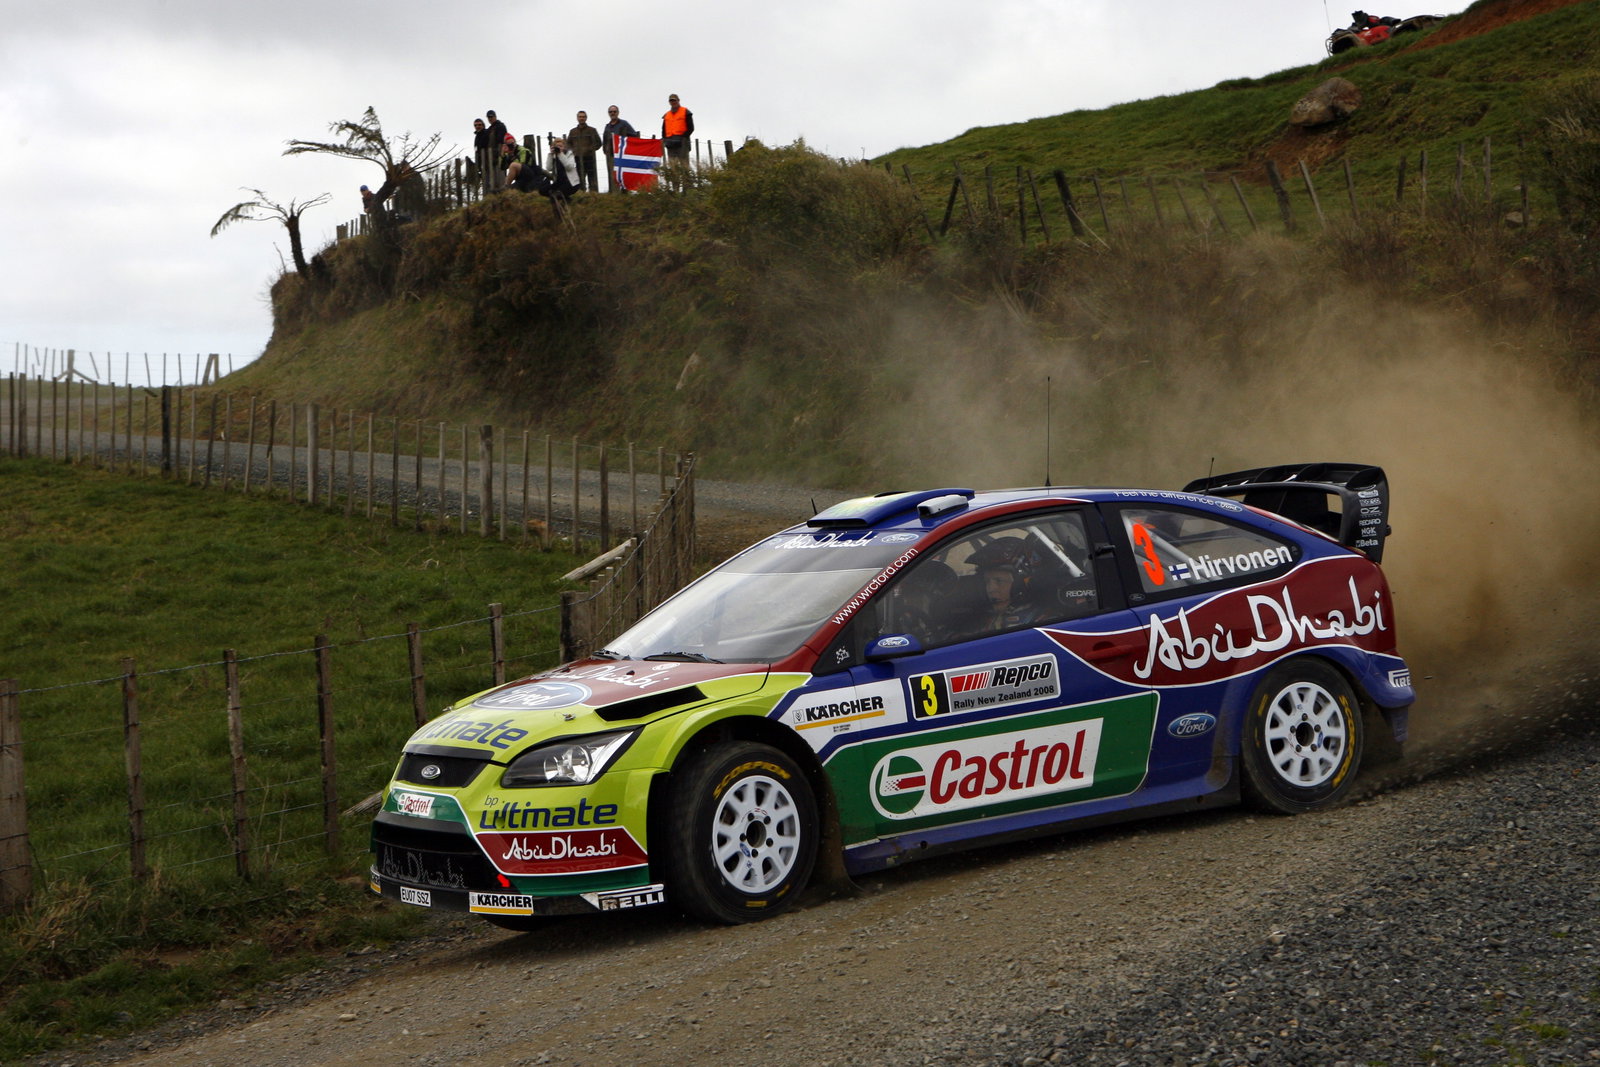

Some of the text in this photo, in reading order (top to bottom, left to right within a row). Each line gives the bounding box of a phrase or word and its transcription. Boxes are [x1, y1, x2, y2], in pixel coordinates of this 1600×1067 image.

[1133, 523, 1165, 586] 3
[1360, 539, 1379, 547] Beta
[1189, 546, 1293, 581] Hirvonen
[832, 548, 919, 625] www.wrcford.com
[1133, 575, 1388, 679] Abu Dhabi
[879, 636, 905, 646] Ford
[920, 661, 1053, 716] 3 Repco
[954, 685, 1055, 709] Rally New Zealand 2008
[806, 696, 884, 722] KÄRCHER
[1174, 713, 1208, 733] Ford
[930, 729, 1087, 805] Castrol
[404, 796, 430, 814] Castrol
[479, 798, 618, 829] ultimate
[484, 795, 498, 806] bp
[502, 833, 618, 860] Abu Dhabi
[401, 888, 430, 905] EU07 SSZ
[477, 893, 532, 908] KÄRCHER
